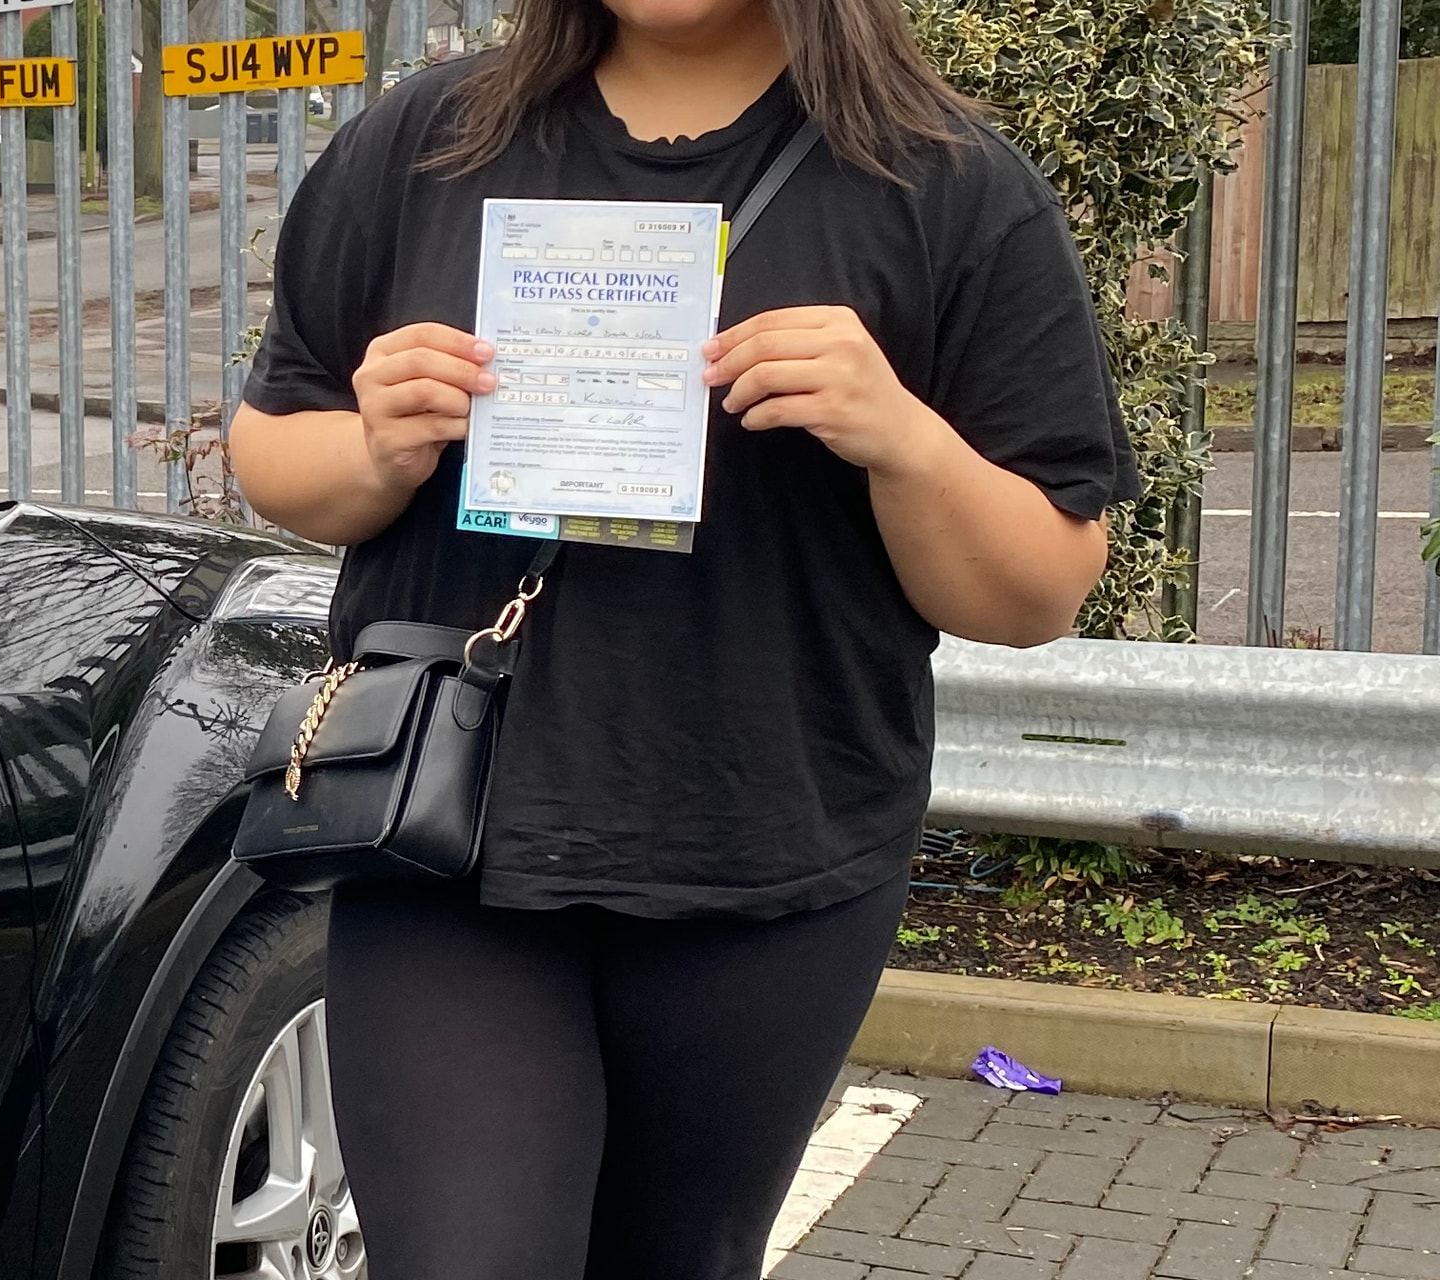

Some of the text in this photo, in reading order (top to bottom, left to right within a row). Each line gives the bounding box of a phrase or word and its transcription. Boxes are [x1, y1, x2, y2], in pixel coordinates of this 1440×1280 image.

[186, 37, 339, 84] SJ14 WYP
[513, 270, 679, 288] PRACTICAL DRIVING
[513, 286, 678, 303] TEST PASS CERTIFICATE
[560, 480, 604, 489] IMPORTANT
[462, 513, 508, 528] A CAR!
